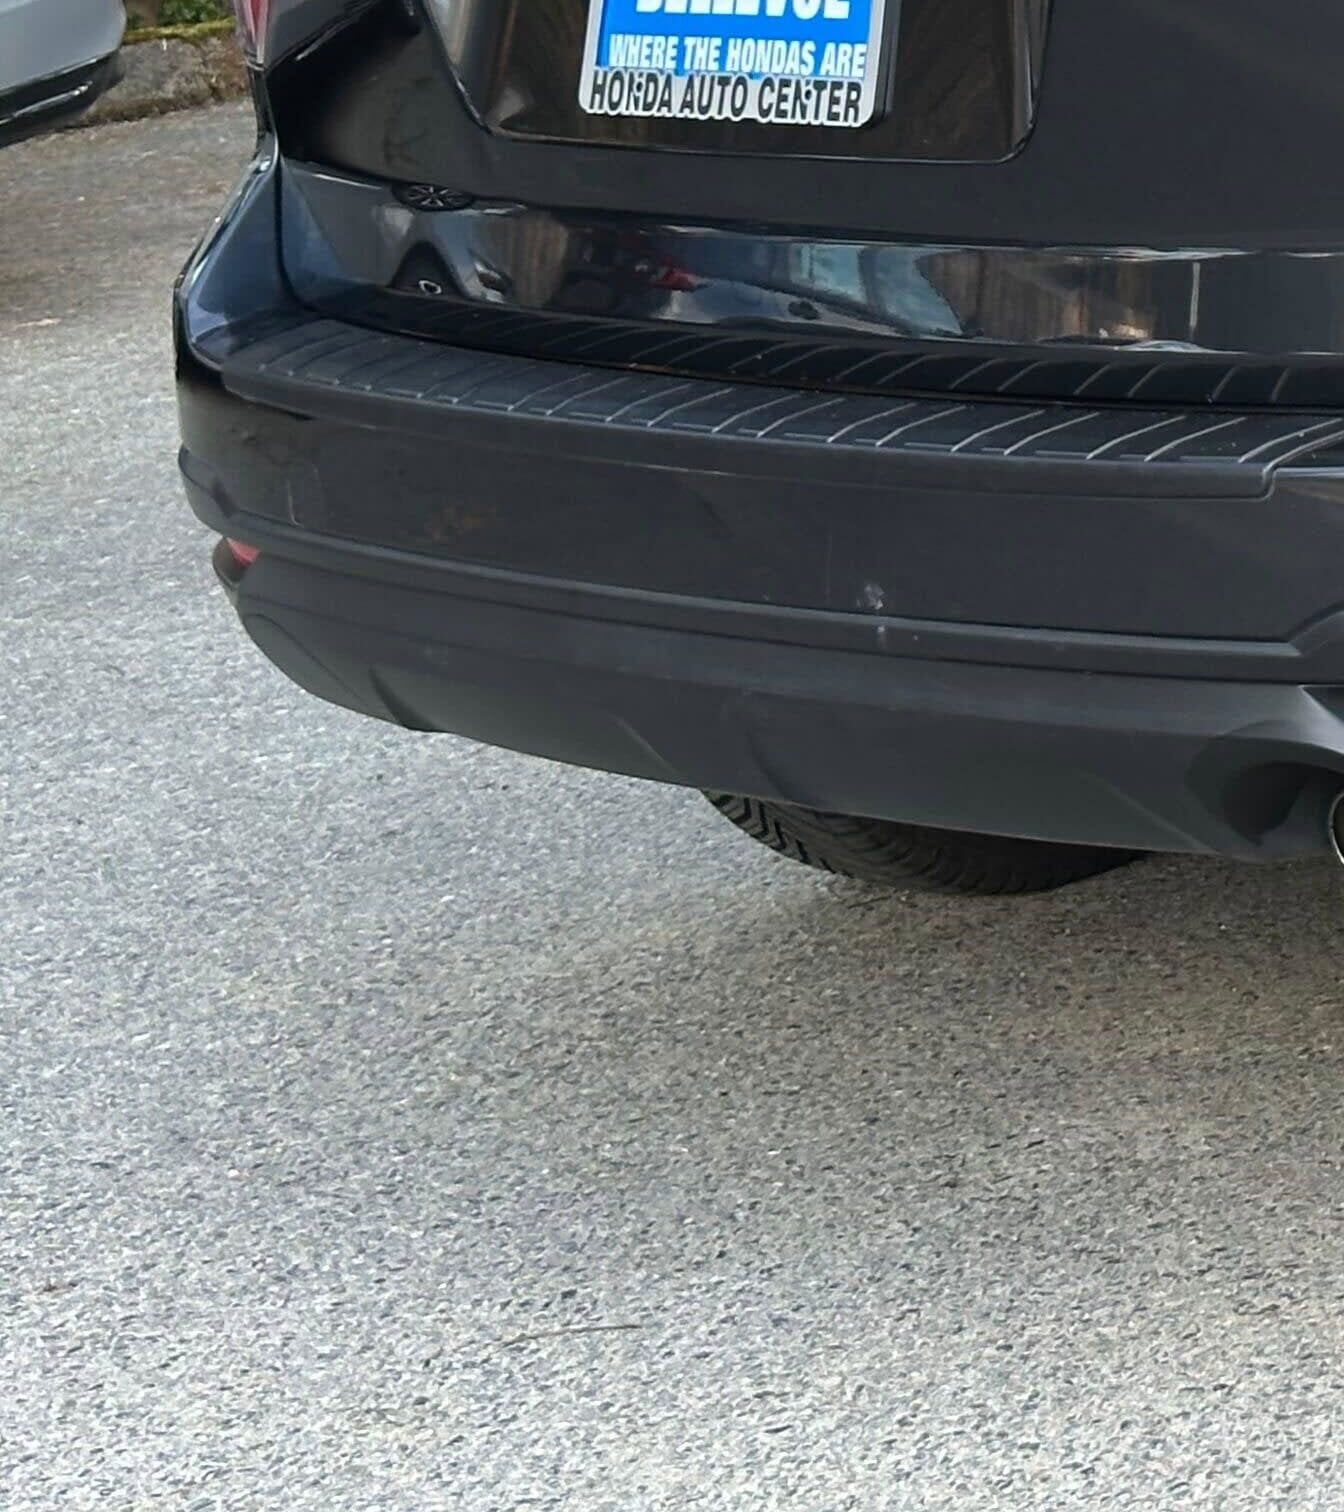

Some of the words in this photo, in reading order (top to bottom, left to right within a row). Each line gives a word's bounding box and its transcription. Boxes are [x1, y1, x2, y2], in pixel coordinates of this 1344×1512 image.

[609, 33, 679, 70] WHERE
[684, 36, 722, 72] THE
[725, 38, 816, 76] HONDAS
[820, 43, 867, 78] ARE
[589, 69, 673, 114] HONDA
[680, 74, 749, 118] AUTO
[758, 78, 863, 124] CENTER
